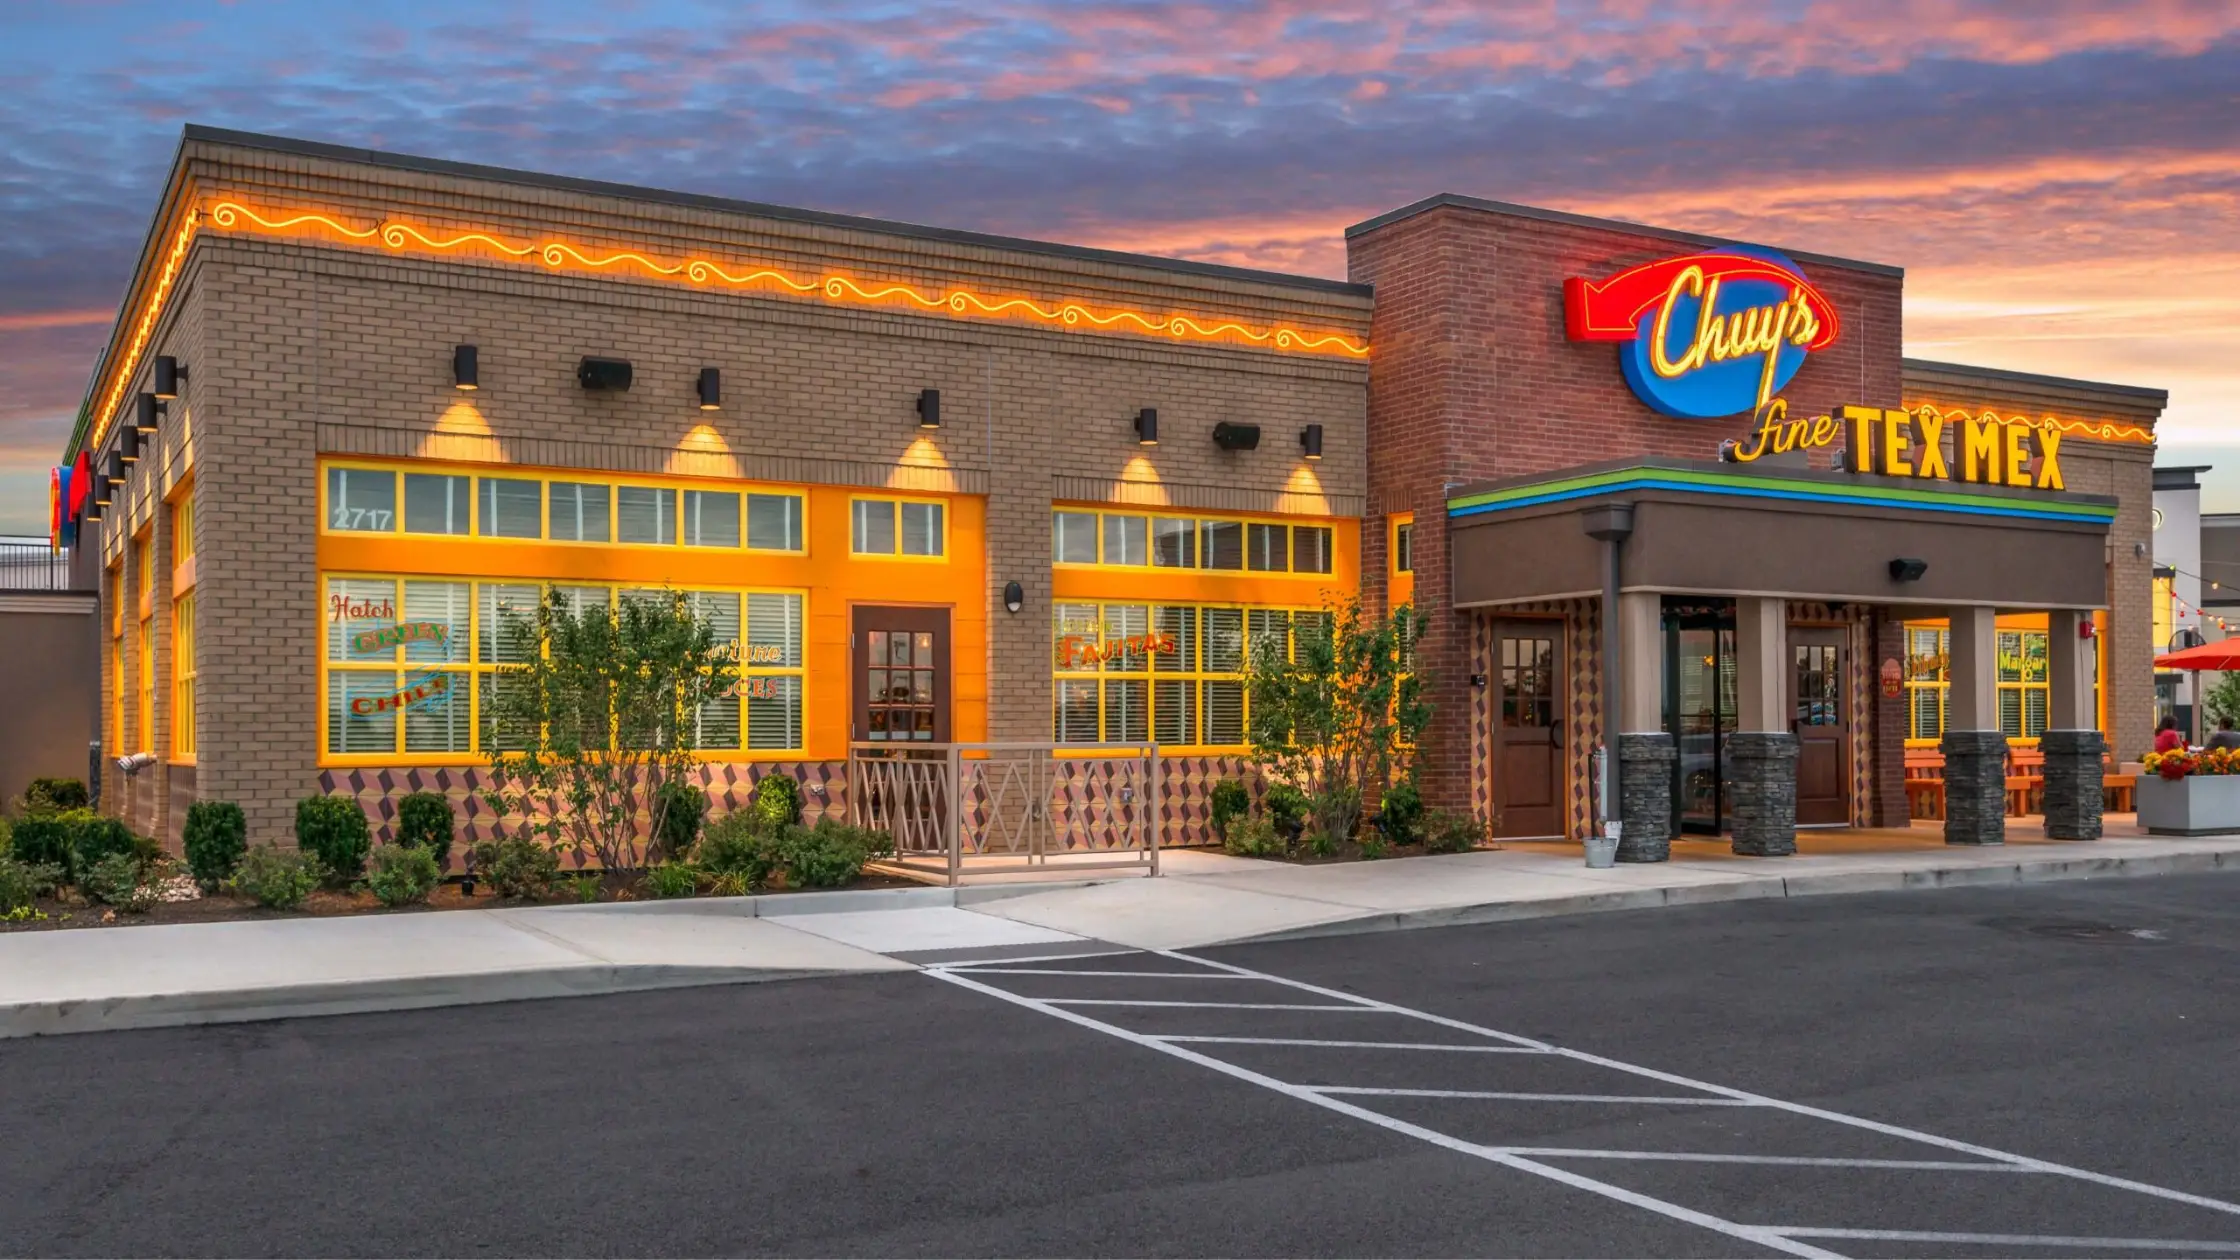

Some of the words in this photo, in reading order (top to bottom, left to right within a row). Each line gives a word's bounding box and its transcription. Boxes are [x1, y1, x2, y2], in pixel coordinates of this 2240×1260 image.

[1651, 264, 1820, 424] Chuy's
[1733, 397, 1840, 462] fine
[1842, 405, 1949, 479] TEX
[1963, 418, 2065, 490] MEX
[333, 507, 393, 530] 2717
[331, 594, 393, 622] Hatch
[1056, 633, 1176, 669] FAJITAS
